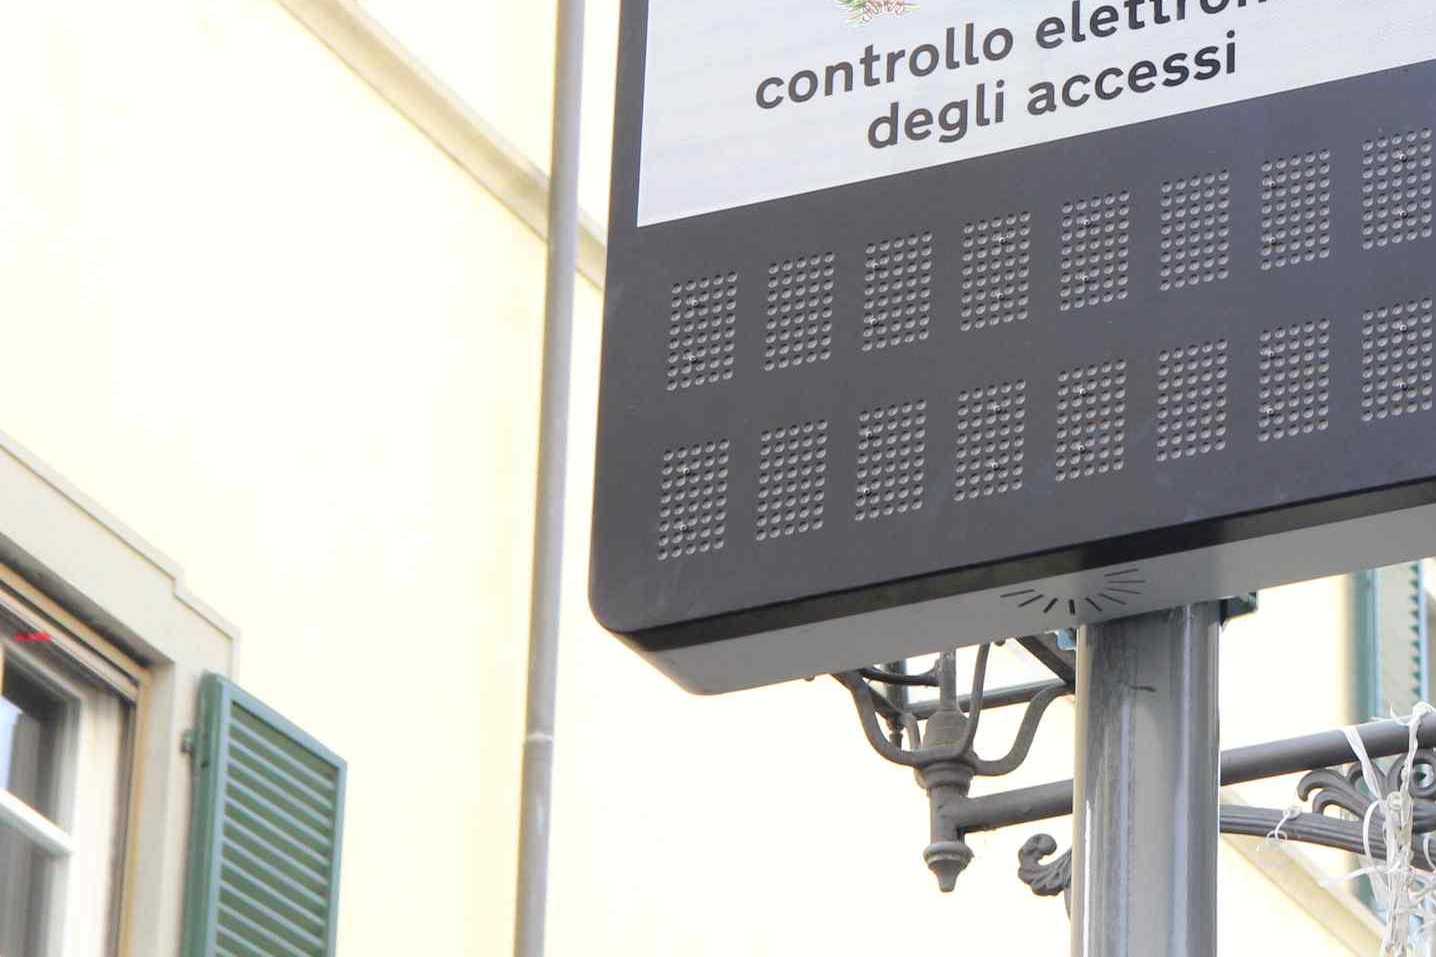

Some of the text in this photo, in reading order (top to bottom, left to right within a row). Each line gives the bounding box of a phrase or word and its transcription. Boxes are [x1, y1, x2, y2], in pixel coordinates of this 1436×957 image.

[755, 16, 1014, 111] controllo
[867, 31, 1237, 150] degli accessi
